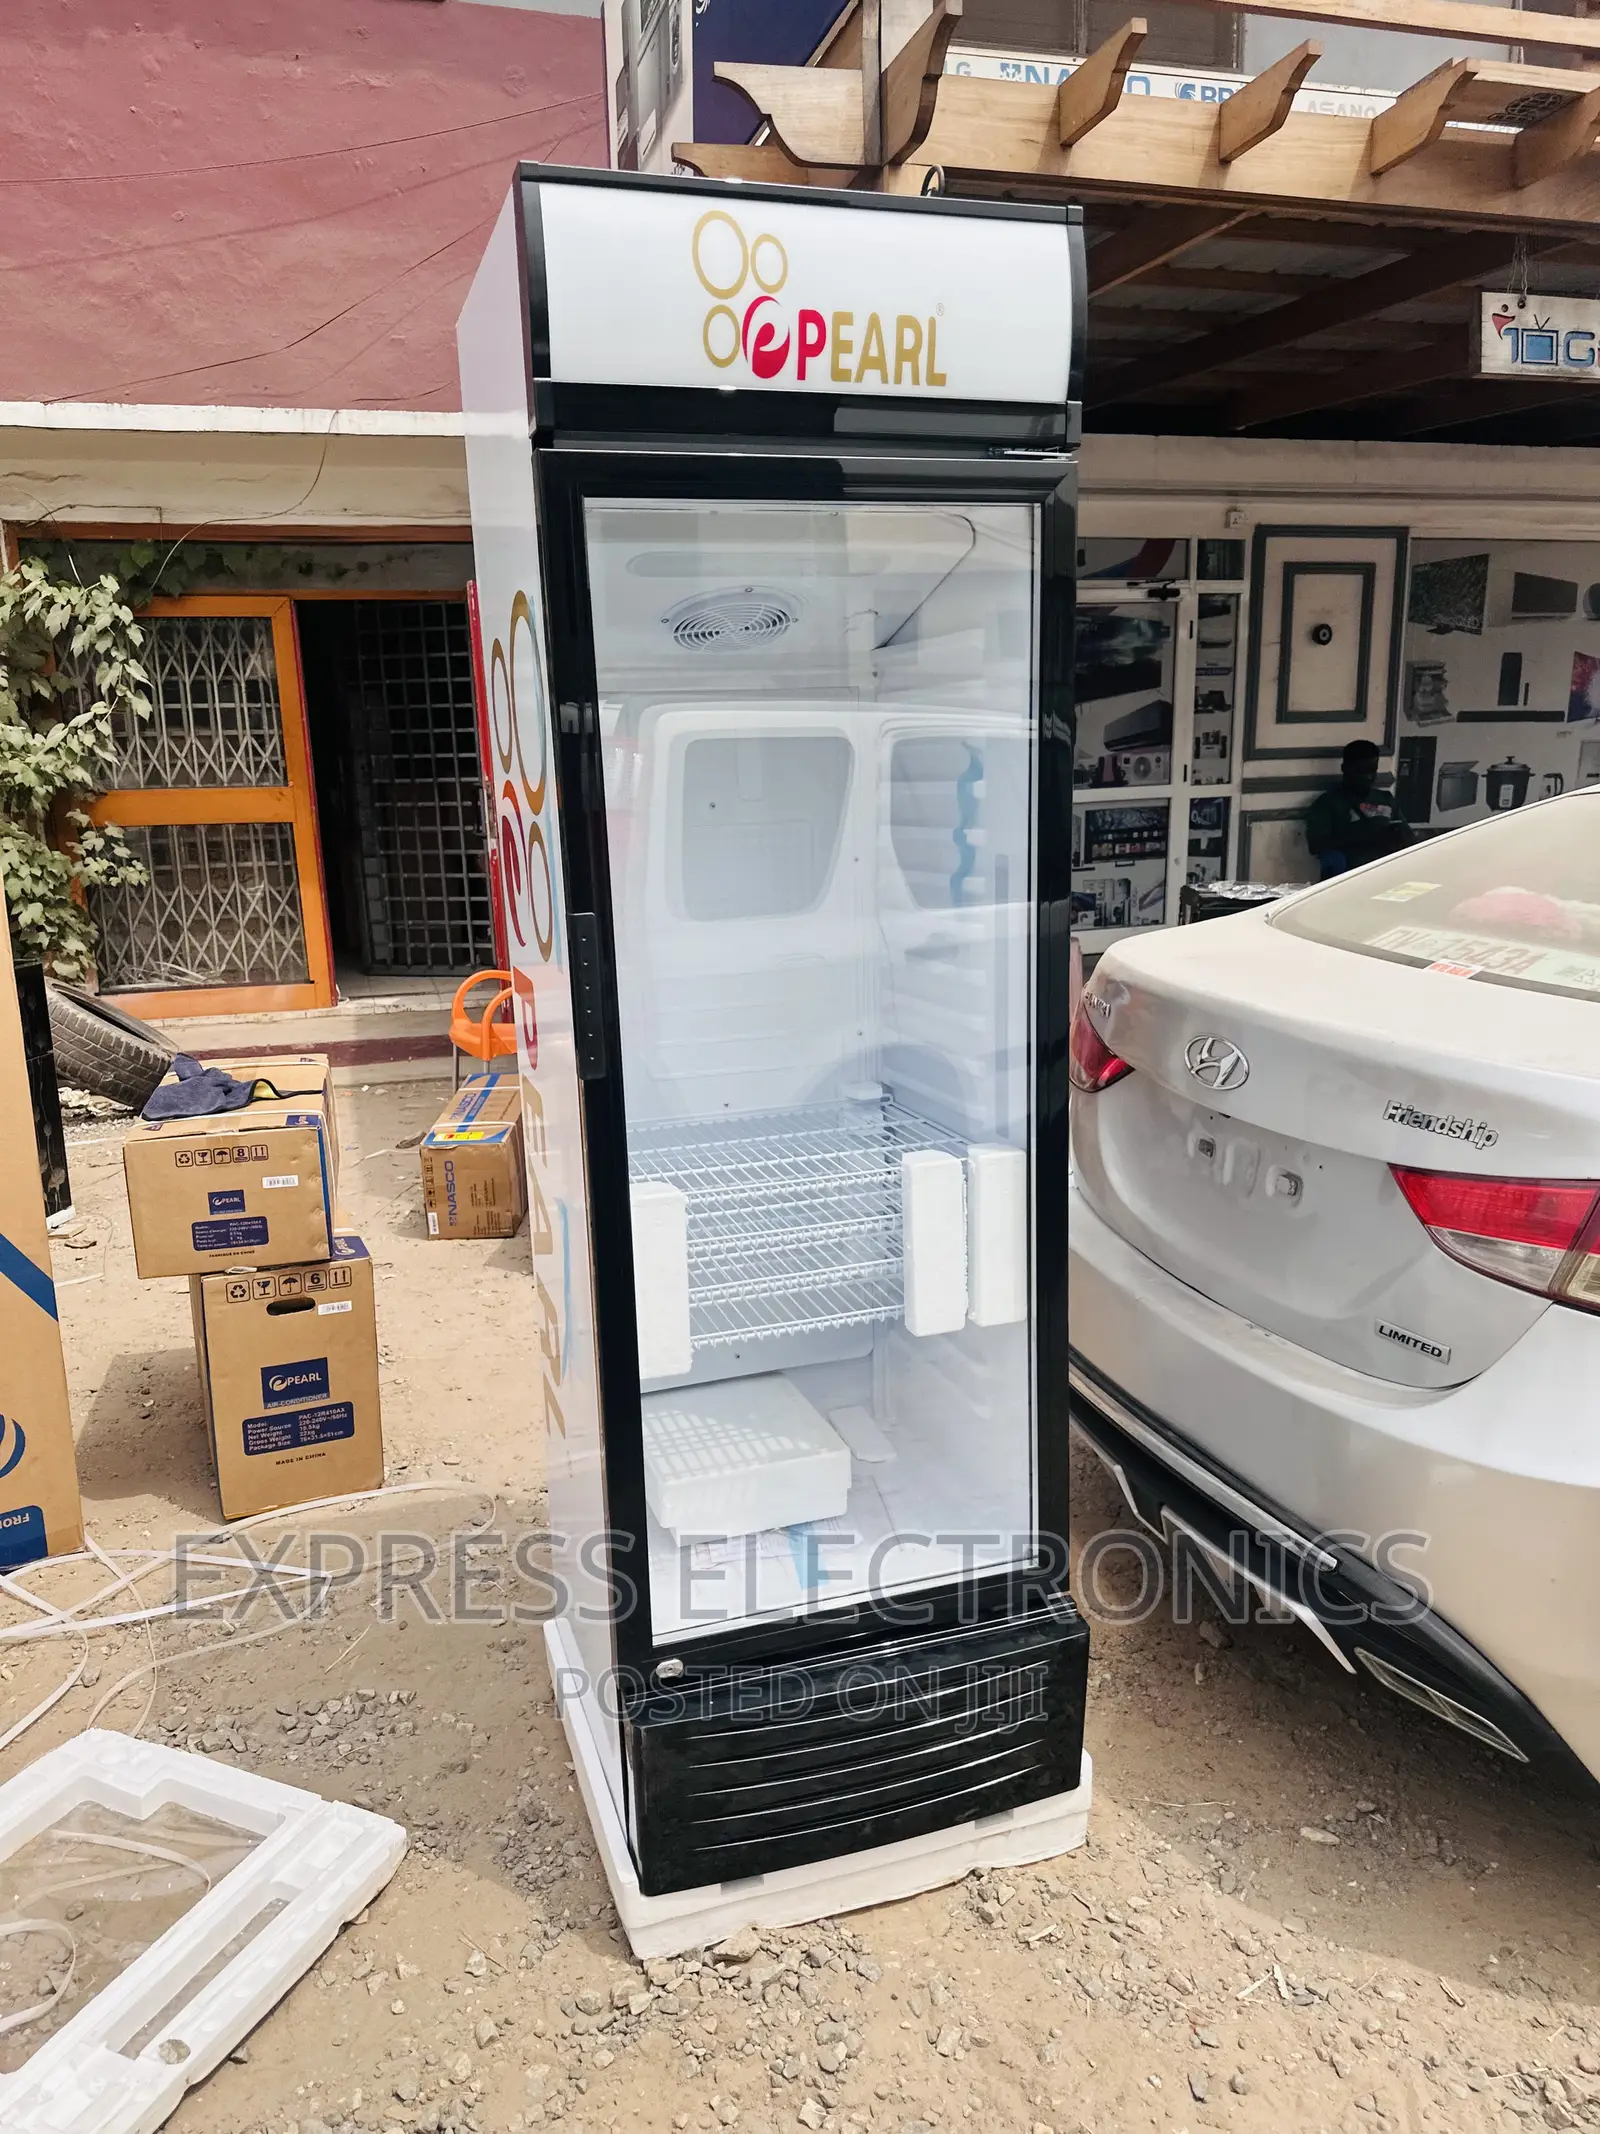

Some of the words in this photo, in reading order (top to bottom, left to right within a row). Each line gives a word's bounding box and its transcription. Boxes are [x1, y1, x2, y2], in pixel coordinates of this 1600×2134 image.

[797, 309, 947, 387] PEARL
[1383, 1099, 1499, 1150] Friendship
[444, 1160, 461, 1215] NASCO
[1378, 1325, 1443, 1359] LIMITED
[287, 1372, 321, 1387] PEARL
[0, 1512, 31, 1530] FRO
